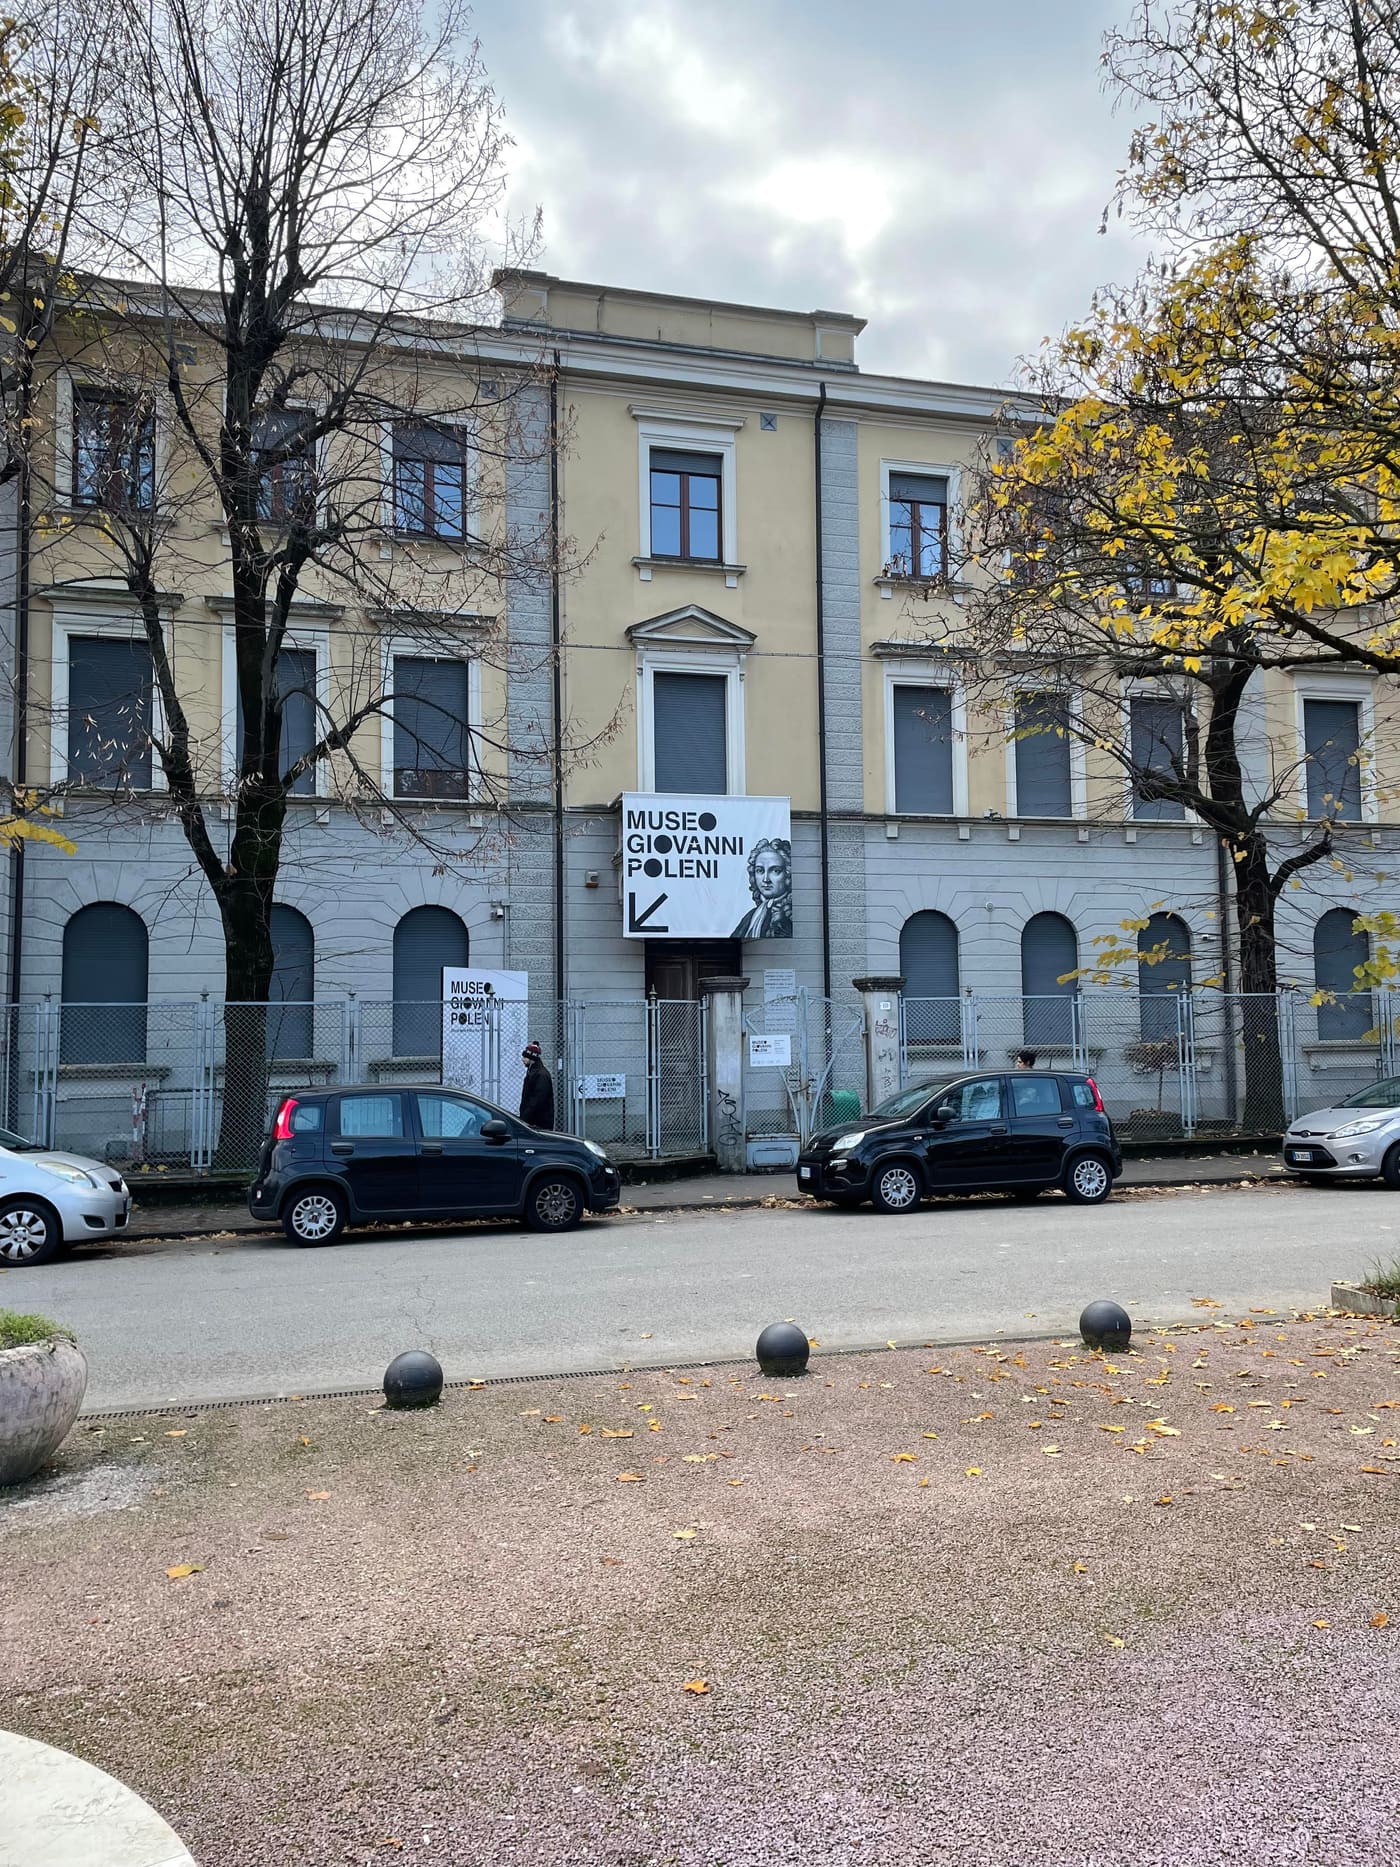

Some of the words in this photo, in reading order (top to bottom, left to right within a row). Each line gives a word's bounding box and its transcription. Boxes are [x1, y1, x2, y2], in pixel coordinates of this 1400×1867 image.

[627, 810, 717, 832] MUSEO
[627, 834, 744, 856] GIOVANNI
[627, 858, 719, 879] POLENI
[451, 981, 493, 995] MUSEO
[451, 1012, 490, 1025] POLEN
